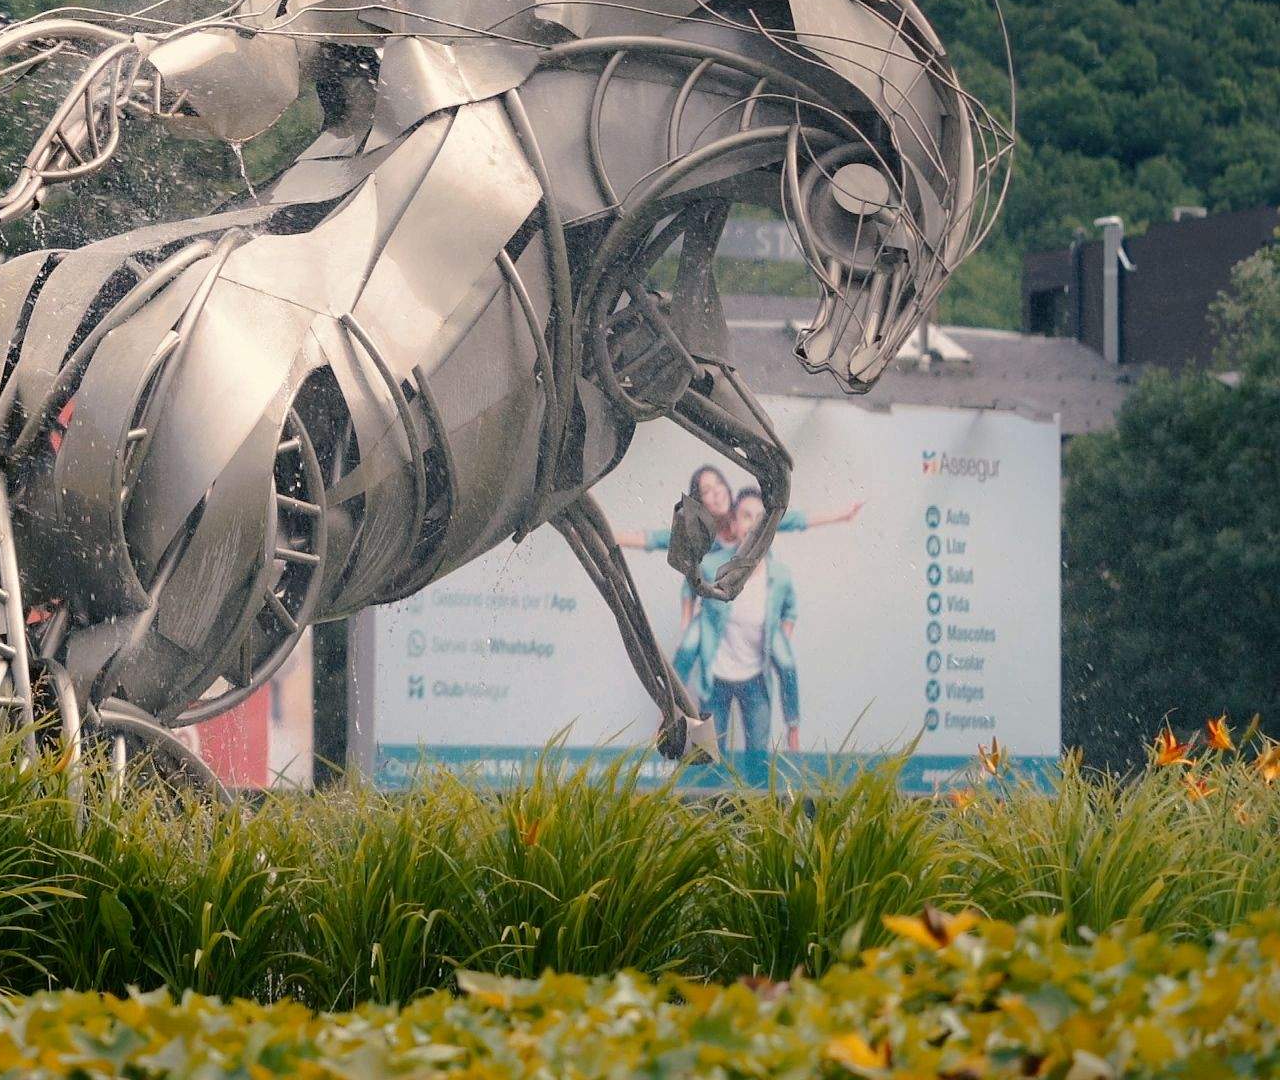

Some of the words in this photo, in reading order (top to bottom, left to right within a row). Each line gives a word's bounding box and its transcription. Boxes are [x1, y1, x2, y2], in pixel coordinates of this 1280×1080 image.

[940, 451, 1001, 482] Assegur
[946, 508, 970, 525] Auto
[947, 566, 973, 584] Salut
[947, 595, 970, 612] Vida
[947, 624, 996, 642] Mascotes
[490, 638, 555, 658] WhatsApp
[946, 653, 984, 671] Escolar
